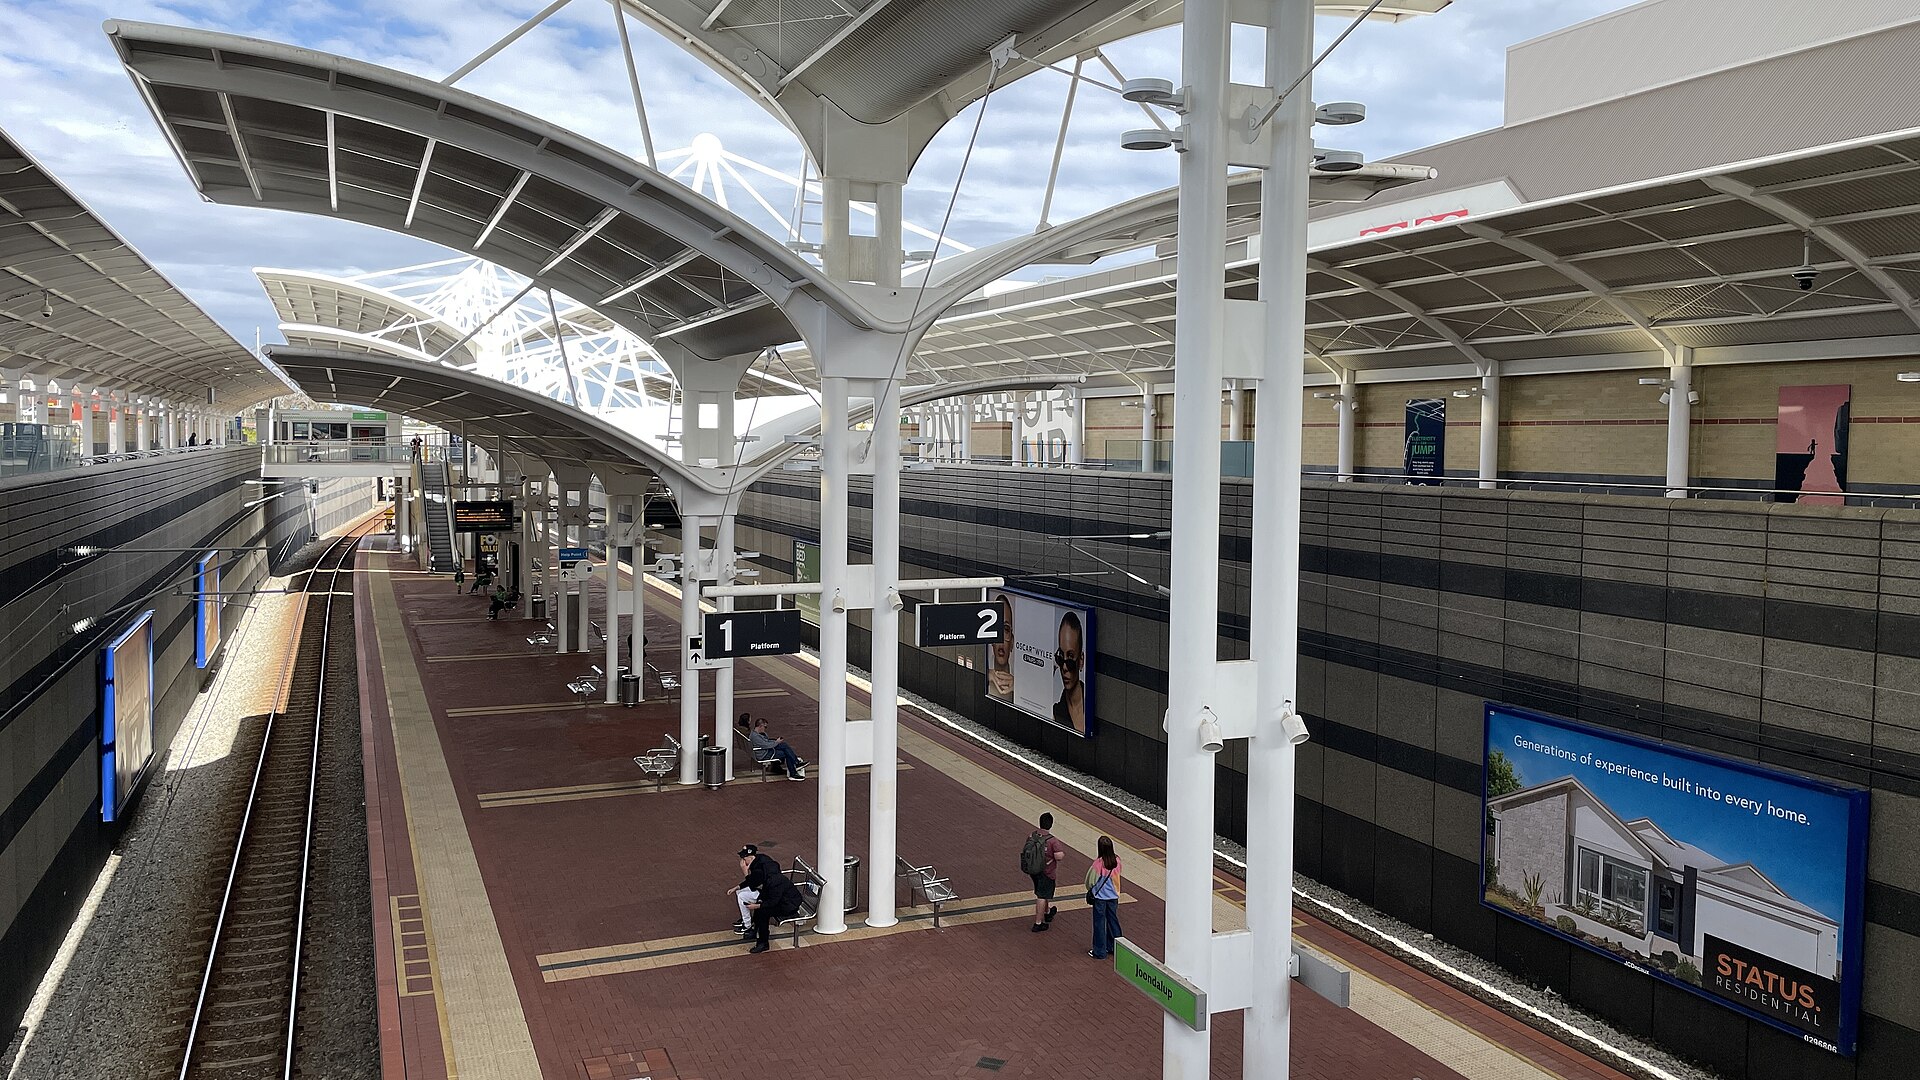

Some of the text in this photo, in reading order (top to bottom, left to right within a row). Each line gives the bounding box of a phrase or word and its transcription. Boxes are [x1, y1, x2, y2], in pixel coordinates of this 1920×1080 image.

[1411, 444, 1436, 455] JUMP!
[719, 619, 733, 652] 1
[976, 608, 998, 639] 2
[750, 642, 780, 650] Platform
[1513, 734, 1811, 826] Generations of experience built into every home.
[1135, 963, 1172, 1000] Joondalup
[1716, 953, 1821, 1012] STATUS.
[1715, 975, 1821, 1027] RESIDENTIAL
[1803, 1034, 1838, 1054] 0296806
